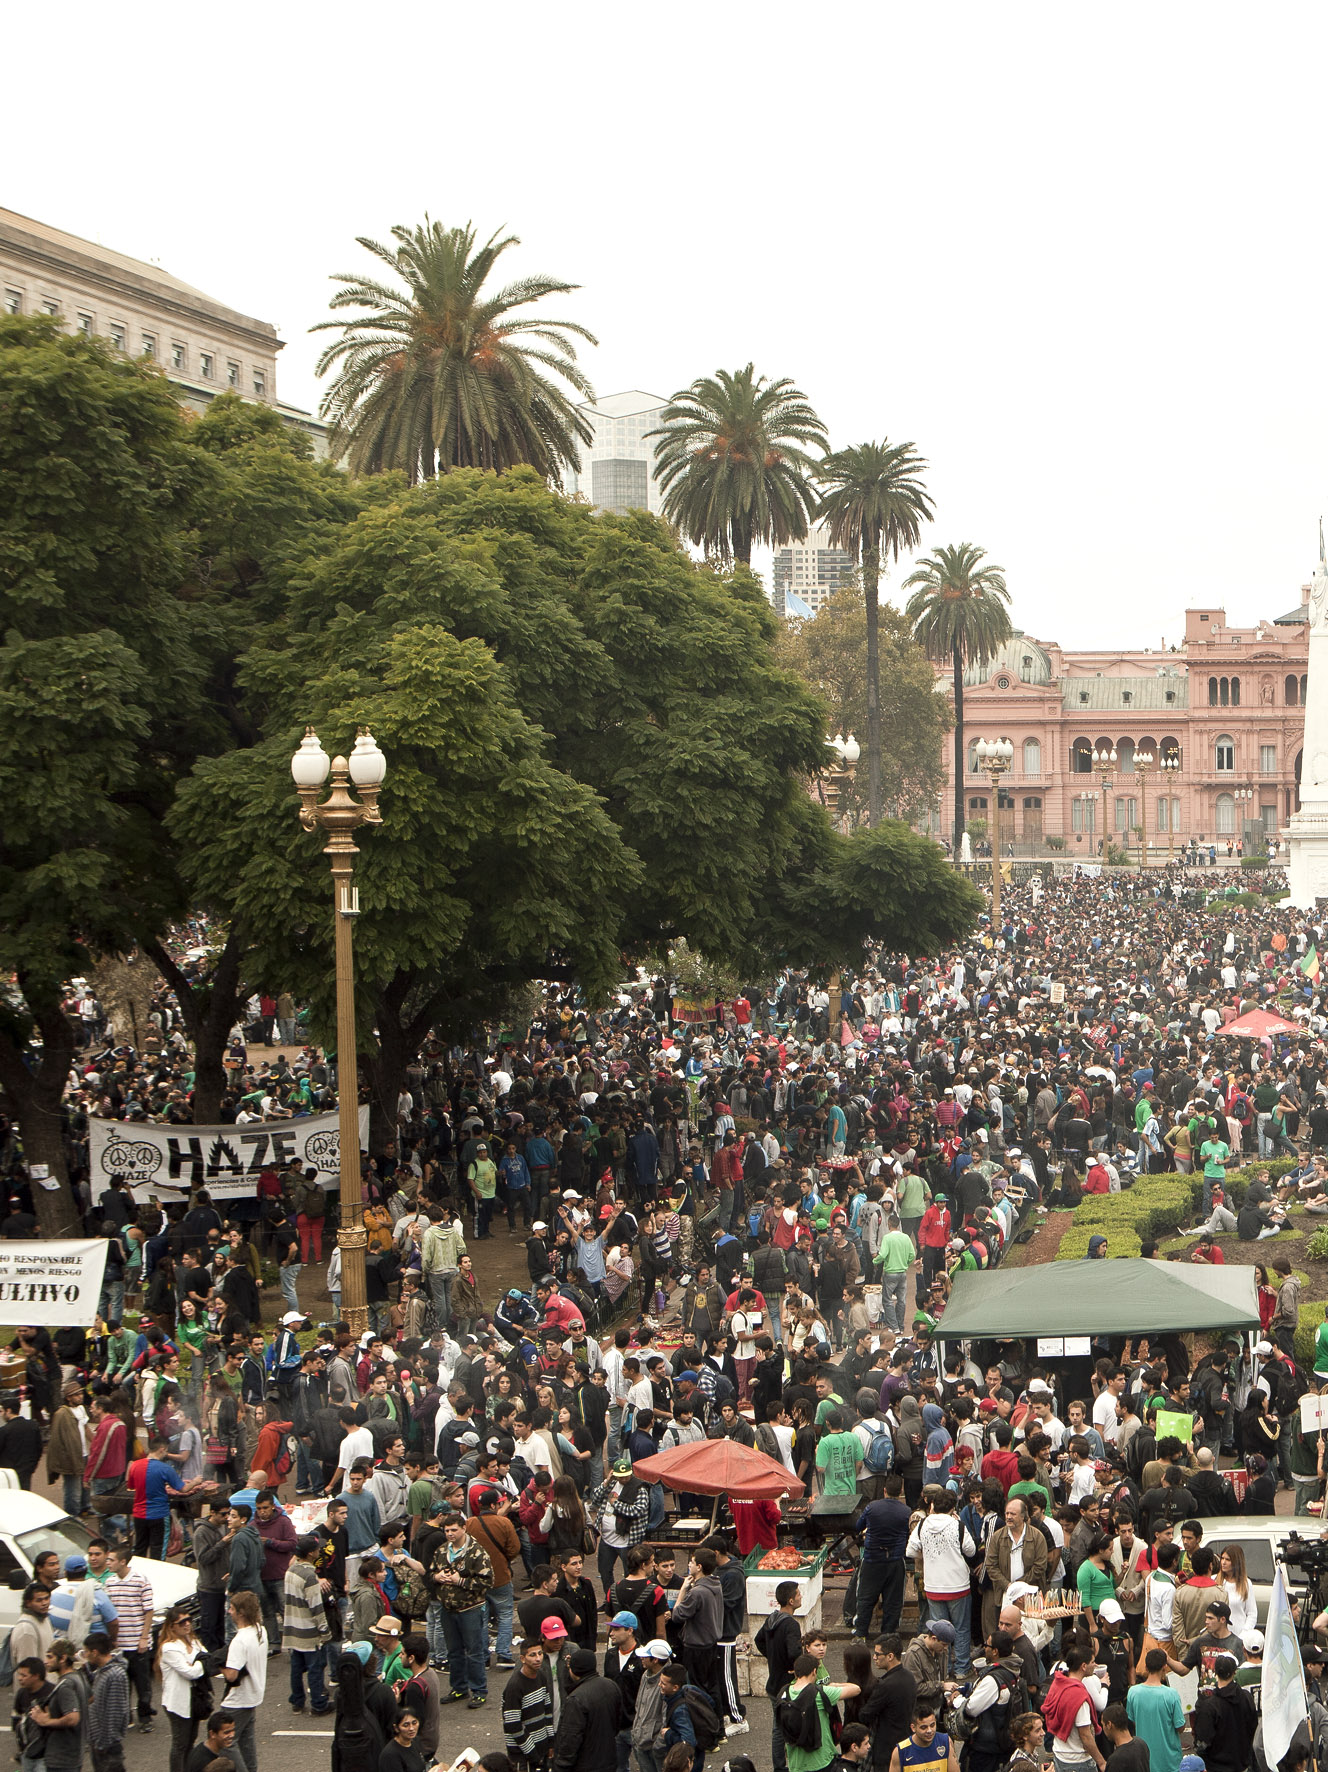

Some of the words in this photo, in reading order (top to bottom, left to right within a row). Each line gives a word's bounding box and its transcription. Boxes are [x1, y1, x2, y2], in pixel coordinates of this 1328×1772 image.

[166, 1131, 297, 1179] HAZE
[14, 1255, 83, 1264] RESPONSABLE
[15, 1267, 45, 1275] MENOS
[48, 1268, 82, 1276] RIESGO
